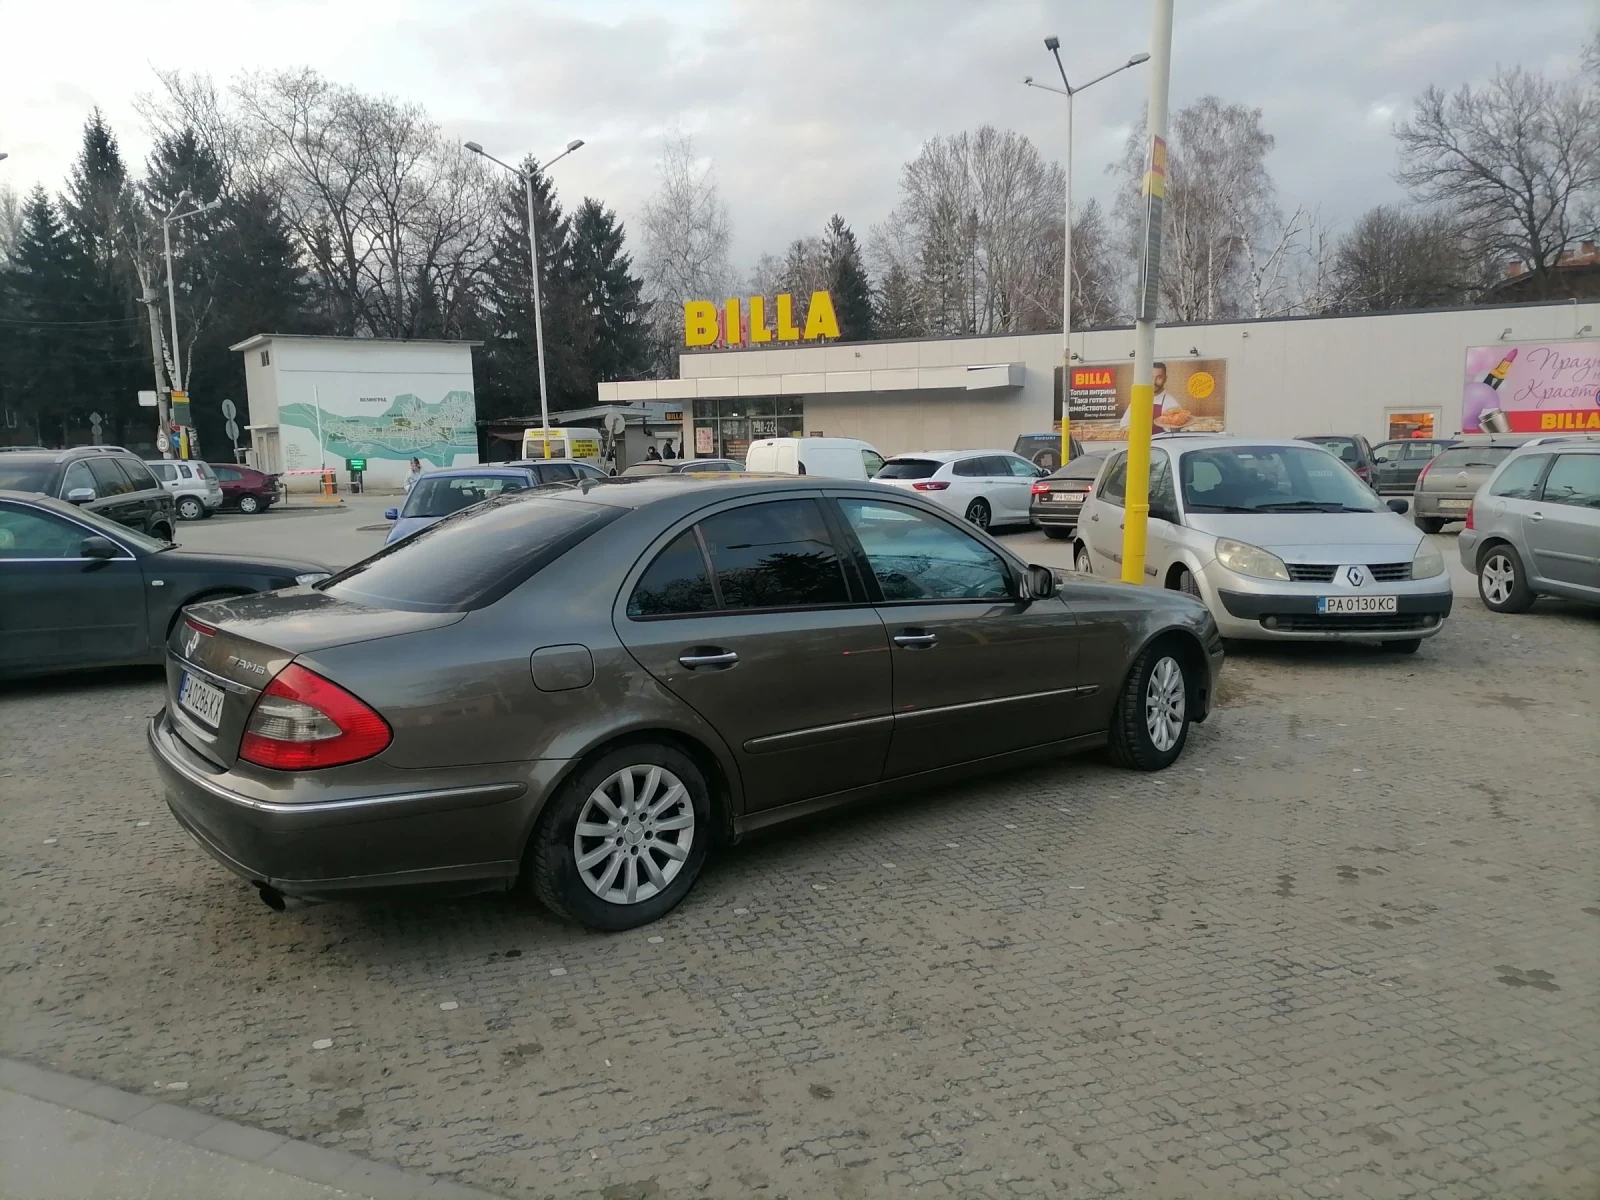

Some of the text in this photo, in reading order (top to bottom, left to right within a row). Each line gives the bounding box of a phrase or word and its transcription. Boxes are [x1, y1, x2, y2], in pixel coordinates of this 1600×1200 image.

[684, 290, 840, 346] BILLA
[1075, 372, 1111, 385] BILLA
[1541, 412, 1600, 429] BILLA
[238, 660, 266, 675] AMG
